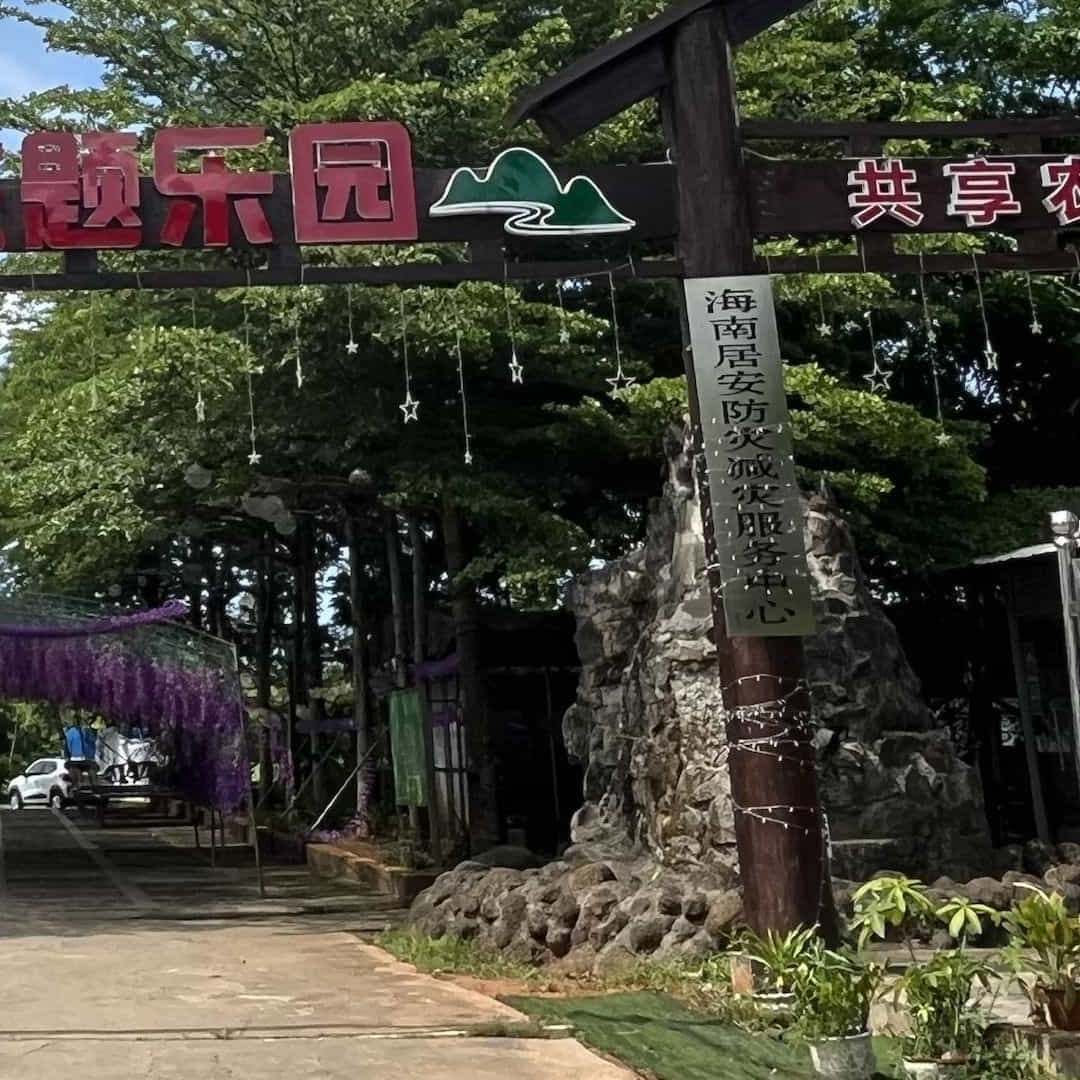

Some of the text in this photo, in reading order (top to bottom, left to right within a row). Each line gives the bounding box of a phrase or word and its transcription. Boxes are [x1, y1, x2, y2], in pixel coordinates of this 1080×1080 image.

[705, 288, 795, 624] 海南居安防灾减灾服务中心
